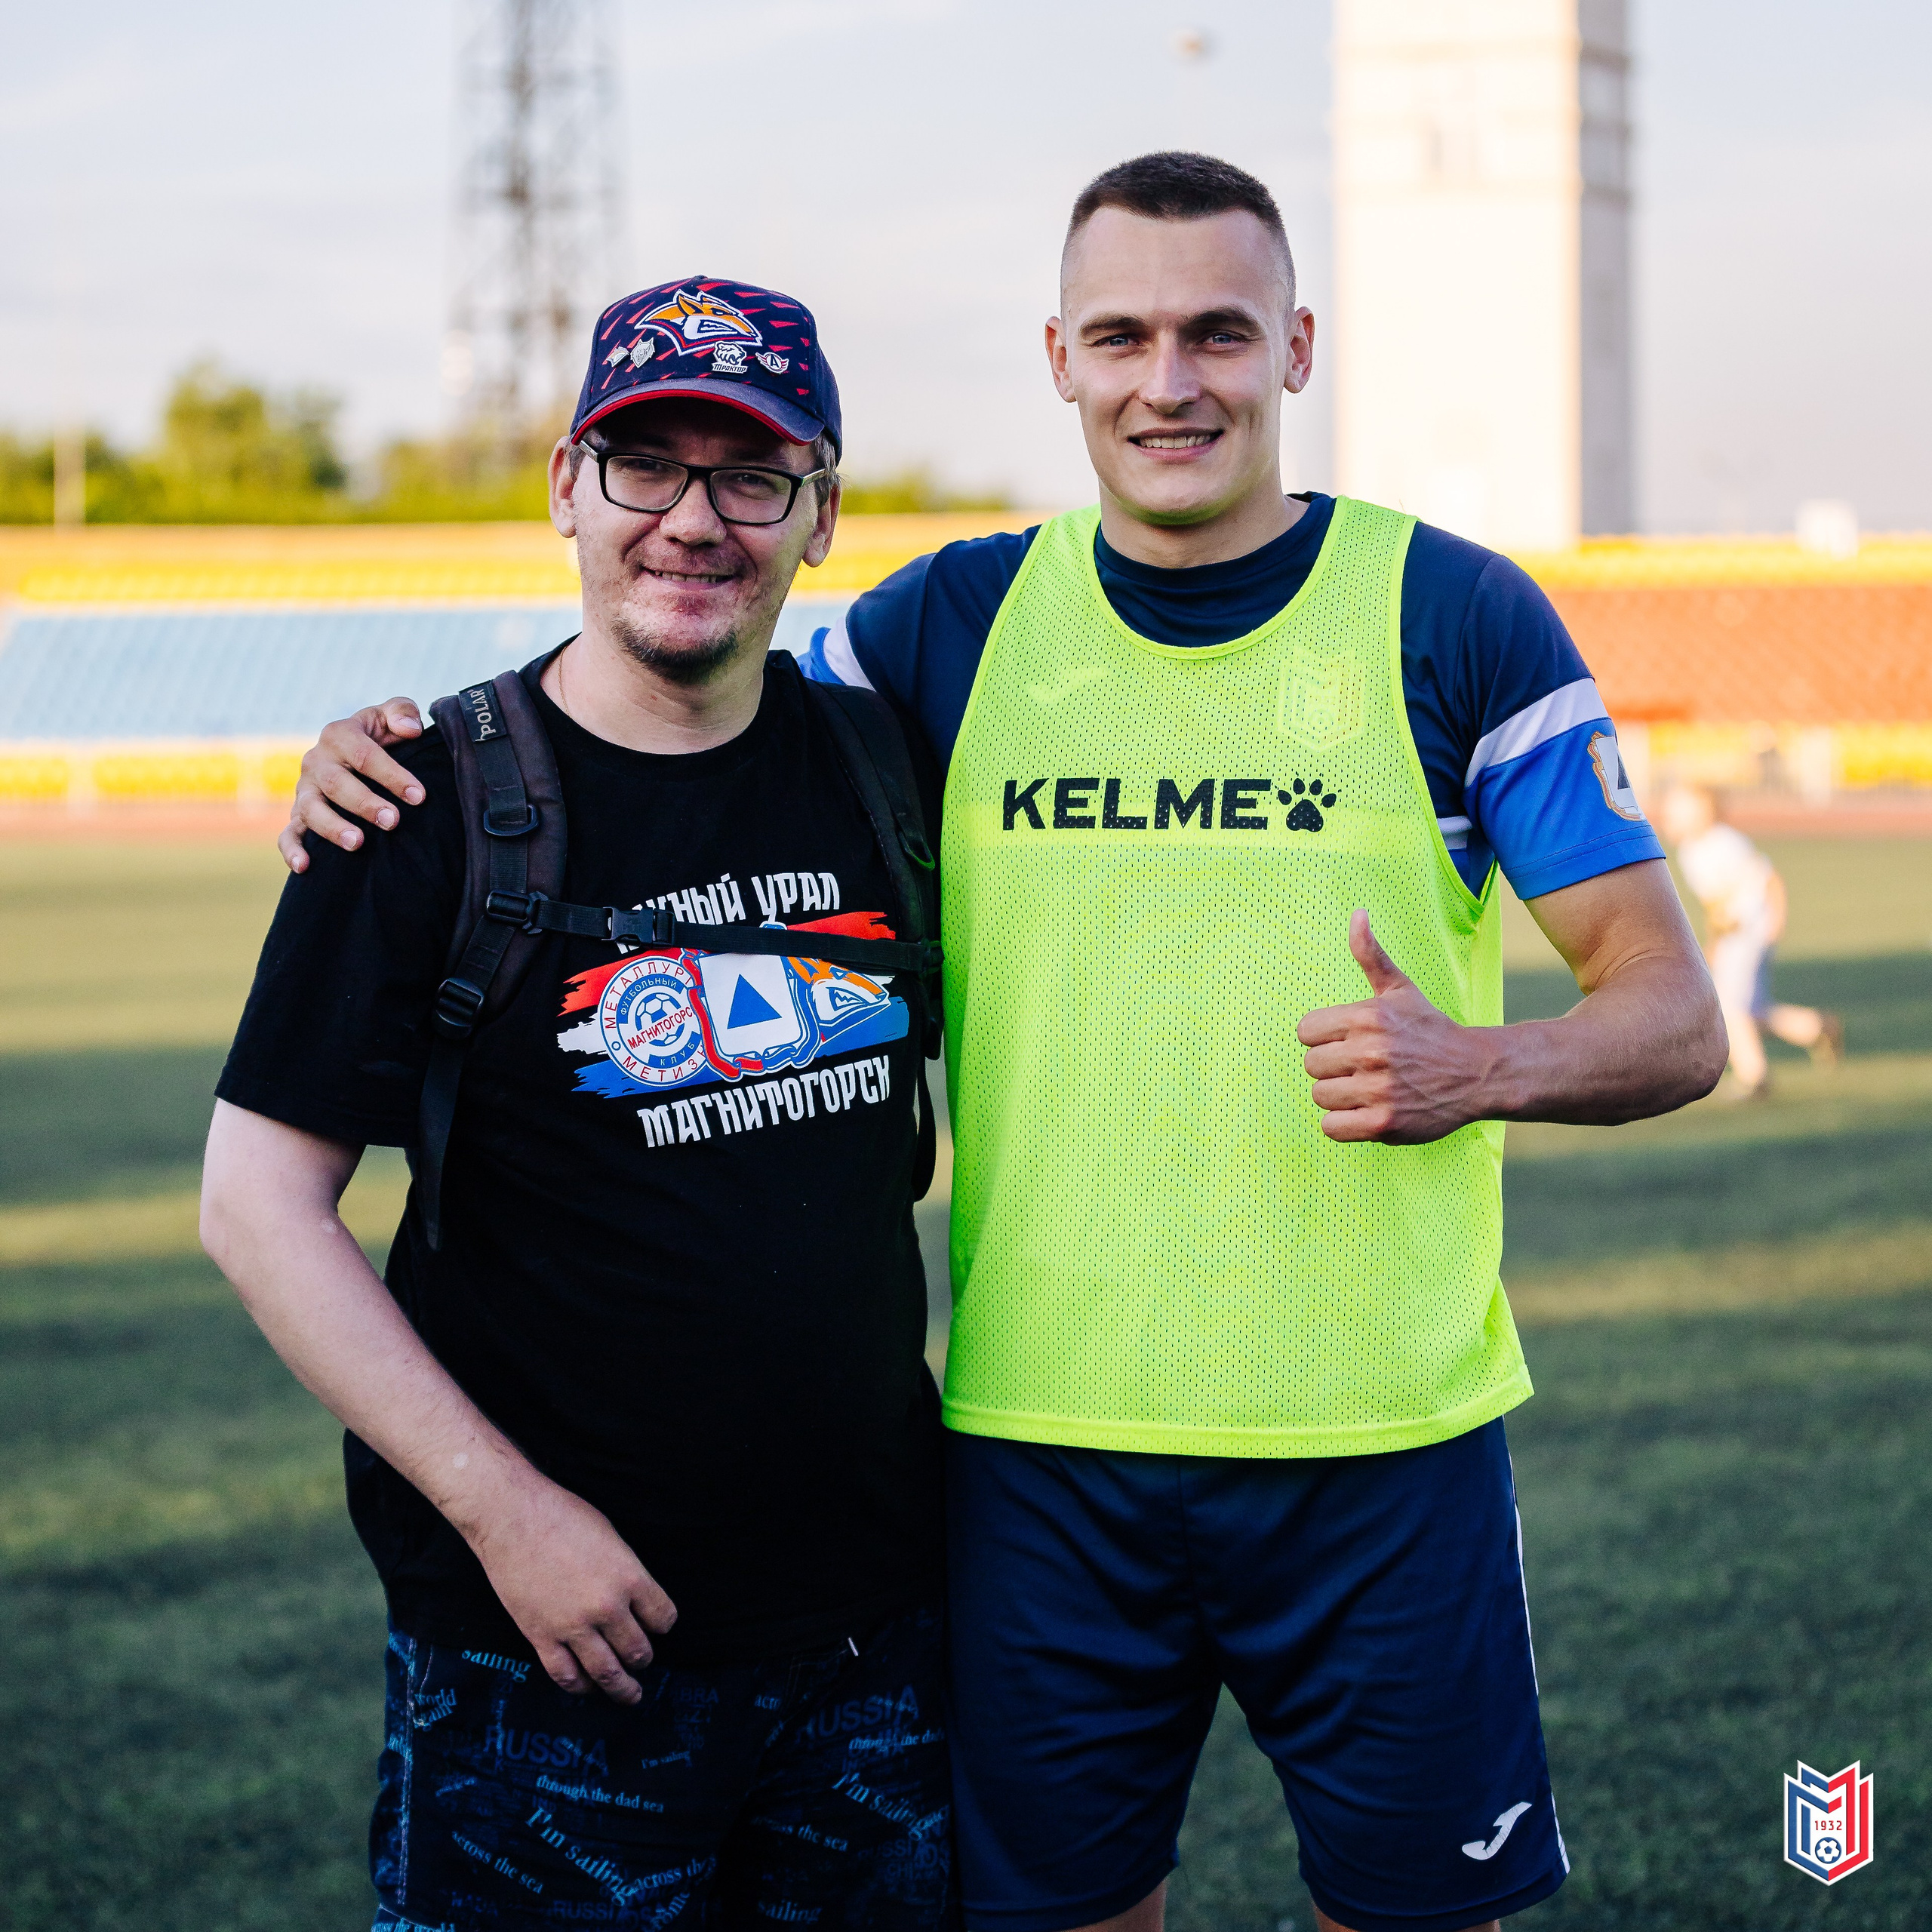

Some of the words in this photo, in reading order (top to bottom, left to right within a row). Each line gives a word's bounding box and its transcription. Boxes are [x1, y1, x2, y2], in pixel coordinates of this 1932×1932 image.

[471, 688, 497, 742] POLAR
[1002, 777, 1272, 830] KELME
[751, 872, 841, 923] УРАЛ
[620, 977, 678, 1016] ФУТБОЛЬНЫЙ
[627, 1005, 695, 1050] МАГНИТОГОРС
[660, 1042, 695, 1066] КЛУБ
[636, 1055, 890, 1149] МАГНИТОГОРСК
[592, 1786, 613, 1804] the
[615, 1790, 641, 1809] dad
[643, 1800, 664, 1814] sea
[452, 1829, 492, 1864] across
[494, 1857, 519, 1879] the
[518, 1873, 544, 1894] sea
[525, 1807, 565, 1849] I'm
[565, 1844, 635, 1907] sailing
